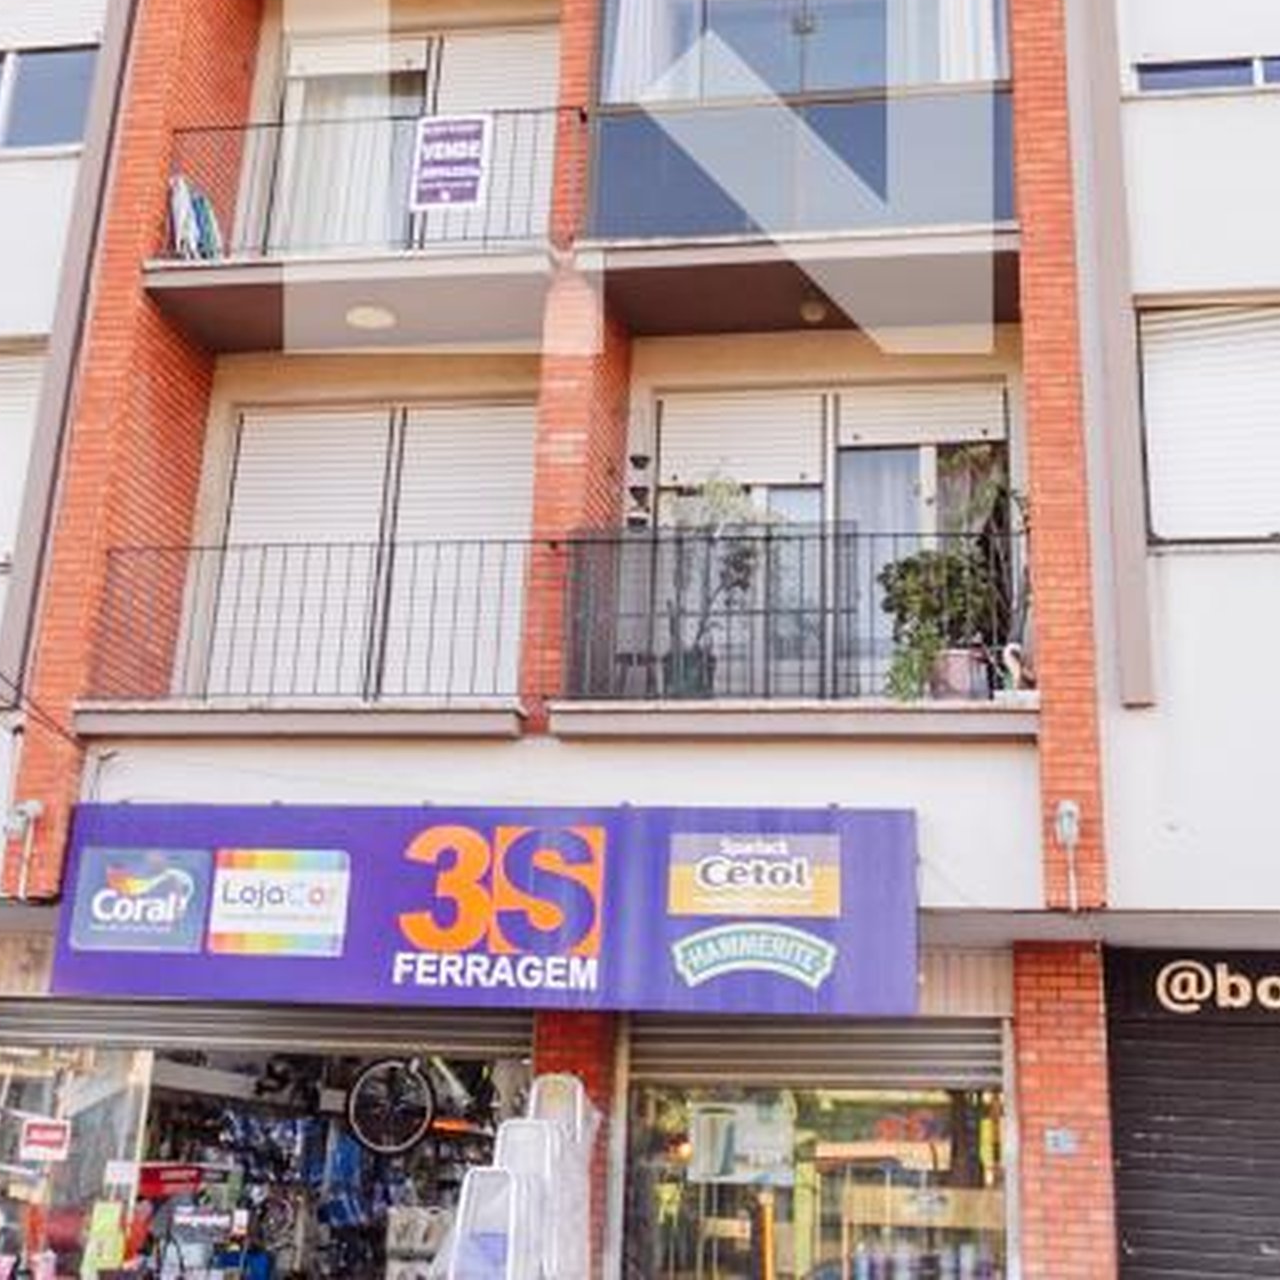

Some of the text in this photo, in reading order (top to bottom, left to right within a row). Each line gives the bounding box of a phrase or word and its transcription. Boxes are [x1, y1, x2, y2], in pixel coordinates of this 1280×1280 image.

[422, 140, 480, 160] VENDE
[699, 856, 808, 889] Cetol
[91, 887, 176, 921] Coral
[222, 880, 339, 908] LojaCo
[399, 825, 600, 954] 3S
[392, 952, 598, 990] FERRAGEM
